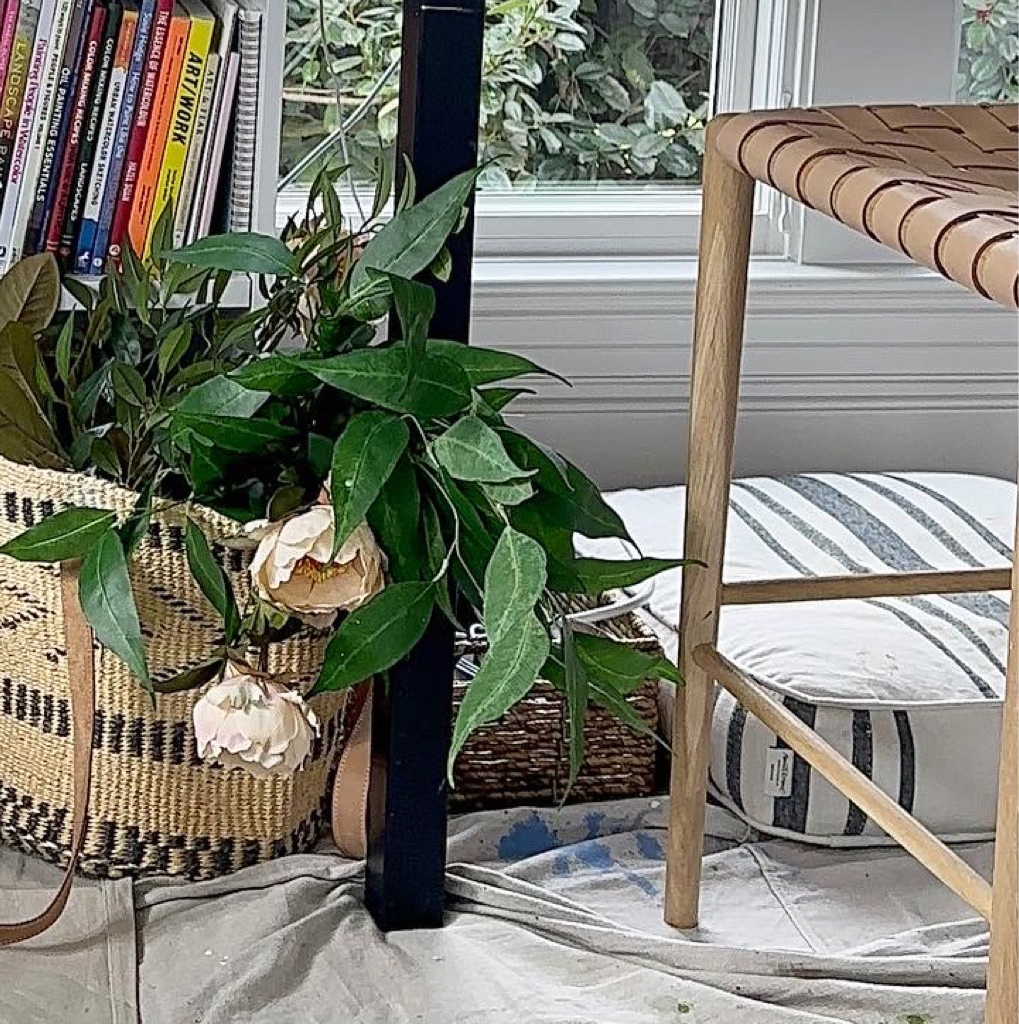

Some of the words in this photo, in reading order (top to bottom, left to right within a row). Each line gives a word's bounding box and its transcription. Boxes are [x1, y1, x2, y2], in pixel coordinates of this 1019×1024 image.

[158, 11, 169, 25] THE
[29, 38, 48, 80] Painting
[84, 40, 98, 70] COLOR
[101, 38, 114, 68] COLOR
[134, 36, 148, 63] Hodge
[149, 26, 166, 59] ESSENCE
[48, 53, 58, 80] PEOPLE
[59, 67, 70, 85] OIL
[128, 71, 140, 89] How
[149, 61, 159, 71] OF
[204, 69, 214, 93] ART
[0, 42, 28, 138] LANDSCAPE
[22, 82, 41, 120] People
[77, 72, 91, 107] MIXING
[94, 70, 108, 104] MIXING
[110, 81, 122, 106] URBAN
[137, 72, 157, 127] WATERCOLOUR
[171, 51, 203, 147] ART/WORK
[201, 96, 208, 104] &
[40, 89, 53, 121] FIGURES
[49, 88, 68, 137] PAINTING
[22, 121, 33, 129] in
[70, 108, 85, 145] RECIPES
[86, 106, 100, 141] RECIPES
[97, 109, 118, 162] WATERCOLOR
[195, 108, 206, 136] FEAR
[10, 129, 30, 184] Watercolor
[36, 140, 59, 202] ESSENTIALS
[70, 163, 88, 222] LANDSCAPES
[91, 163, 108, 206] SKETCHING
